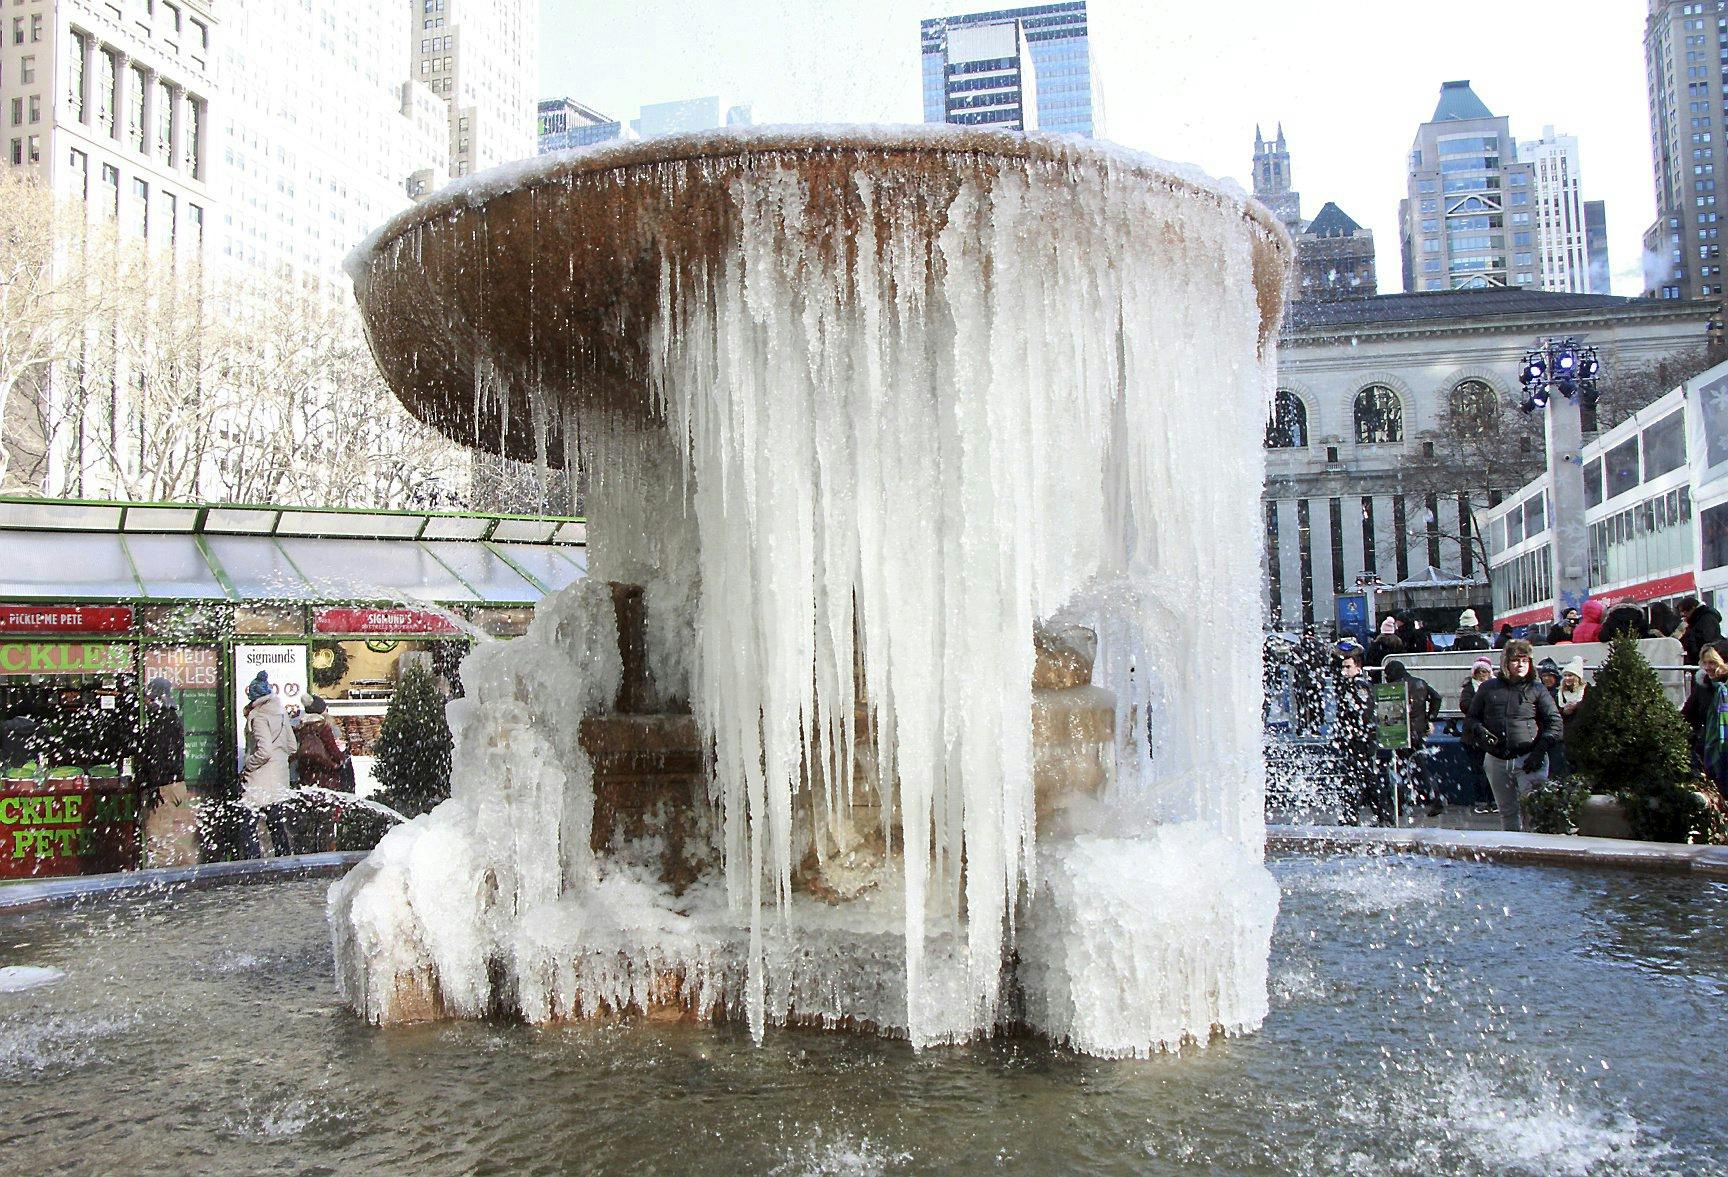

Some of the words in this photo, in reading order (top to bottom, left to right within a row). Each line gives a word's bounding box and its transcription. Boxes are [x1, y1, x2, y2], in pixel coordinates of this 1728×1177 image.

[45, 613, 58, 625] ME
[60, 613, 83, 625] PETE
[147, 666, 216, 684] PICKLES
